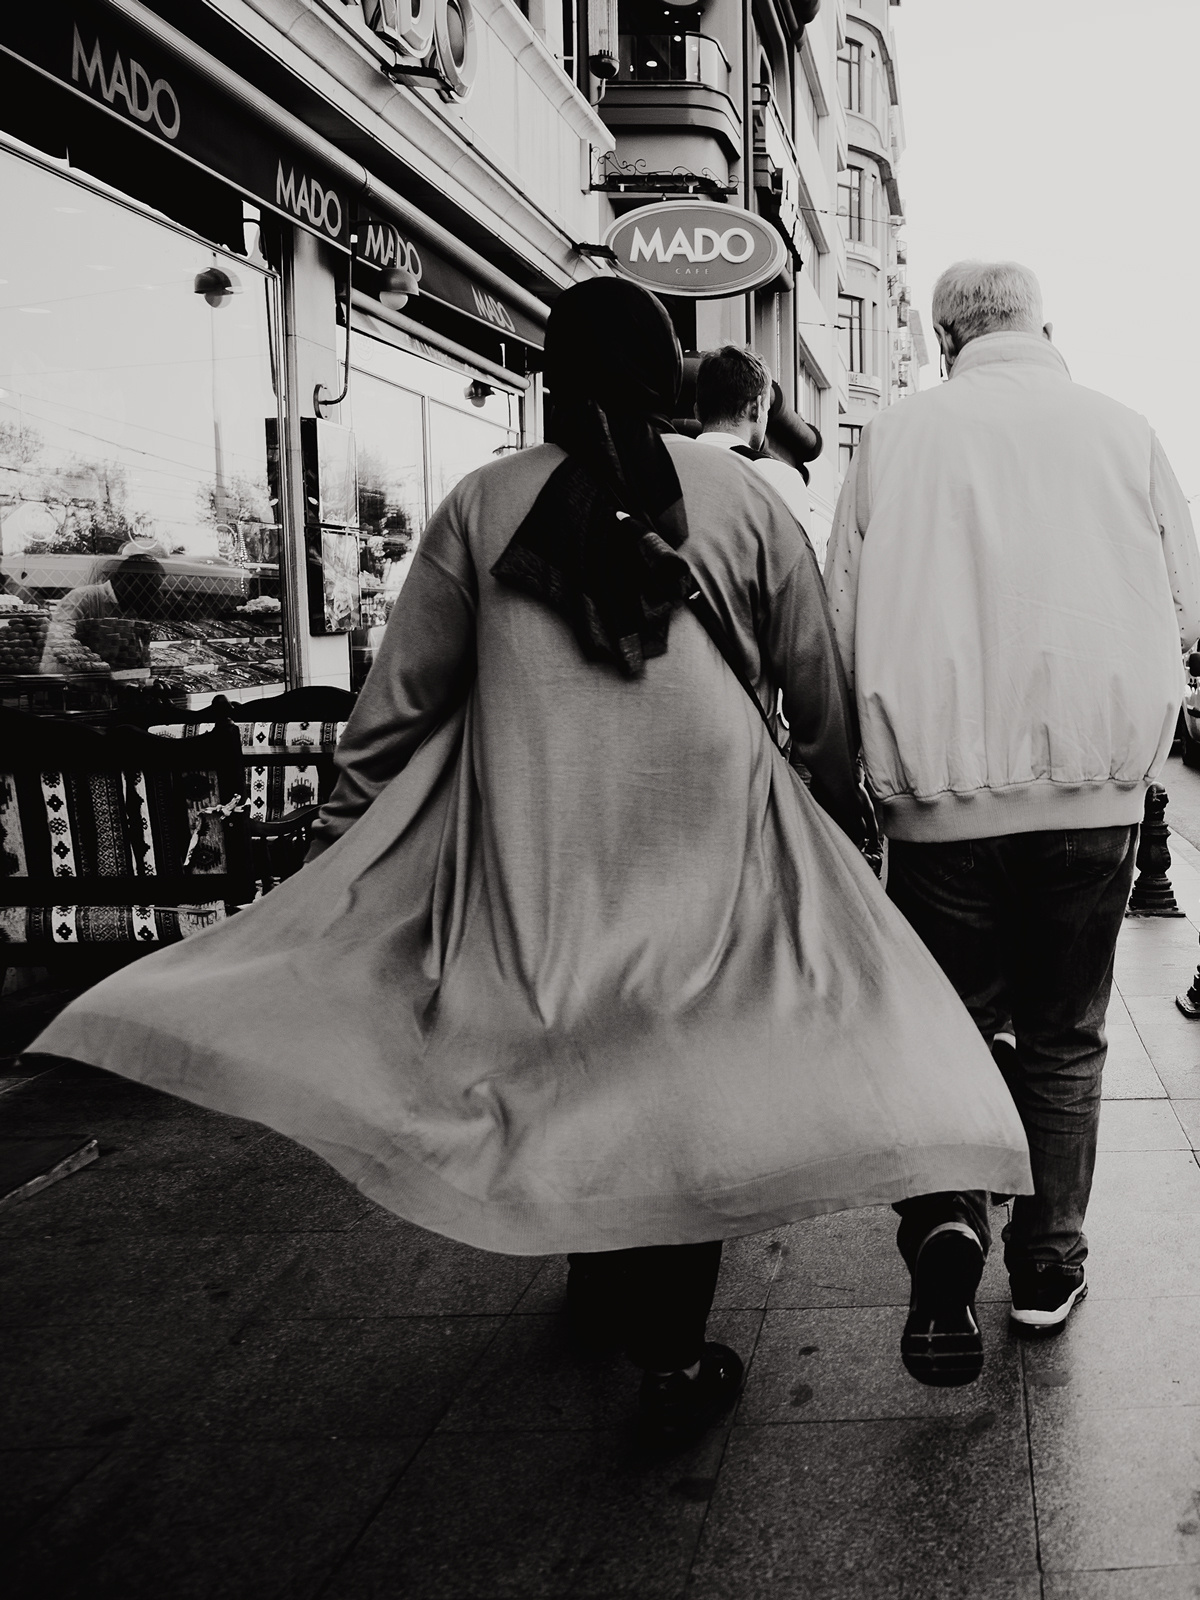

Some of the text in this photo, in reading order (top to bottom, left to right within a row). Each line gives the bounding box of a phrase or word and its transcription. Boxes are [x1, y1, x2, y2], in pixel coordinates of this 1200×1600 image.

[71, 20, 181, 140] MADO
[276, 158, 342, 238] MADO
[364, 216, 423, 283] MADO
[629, 226, 755, 264] MADO
[470, 283, 516, 333] MADO
